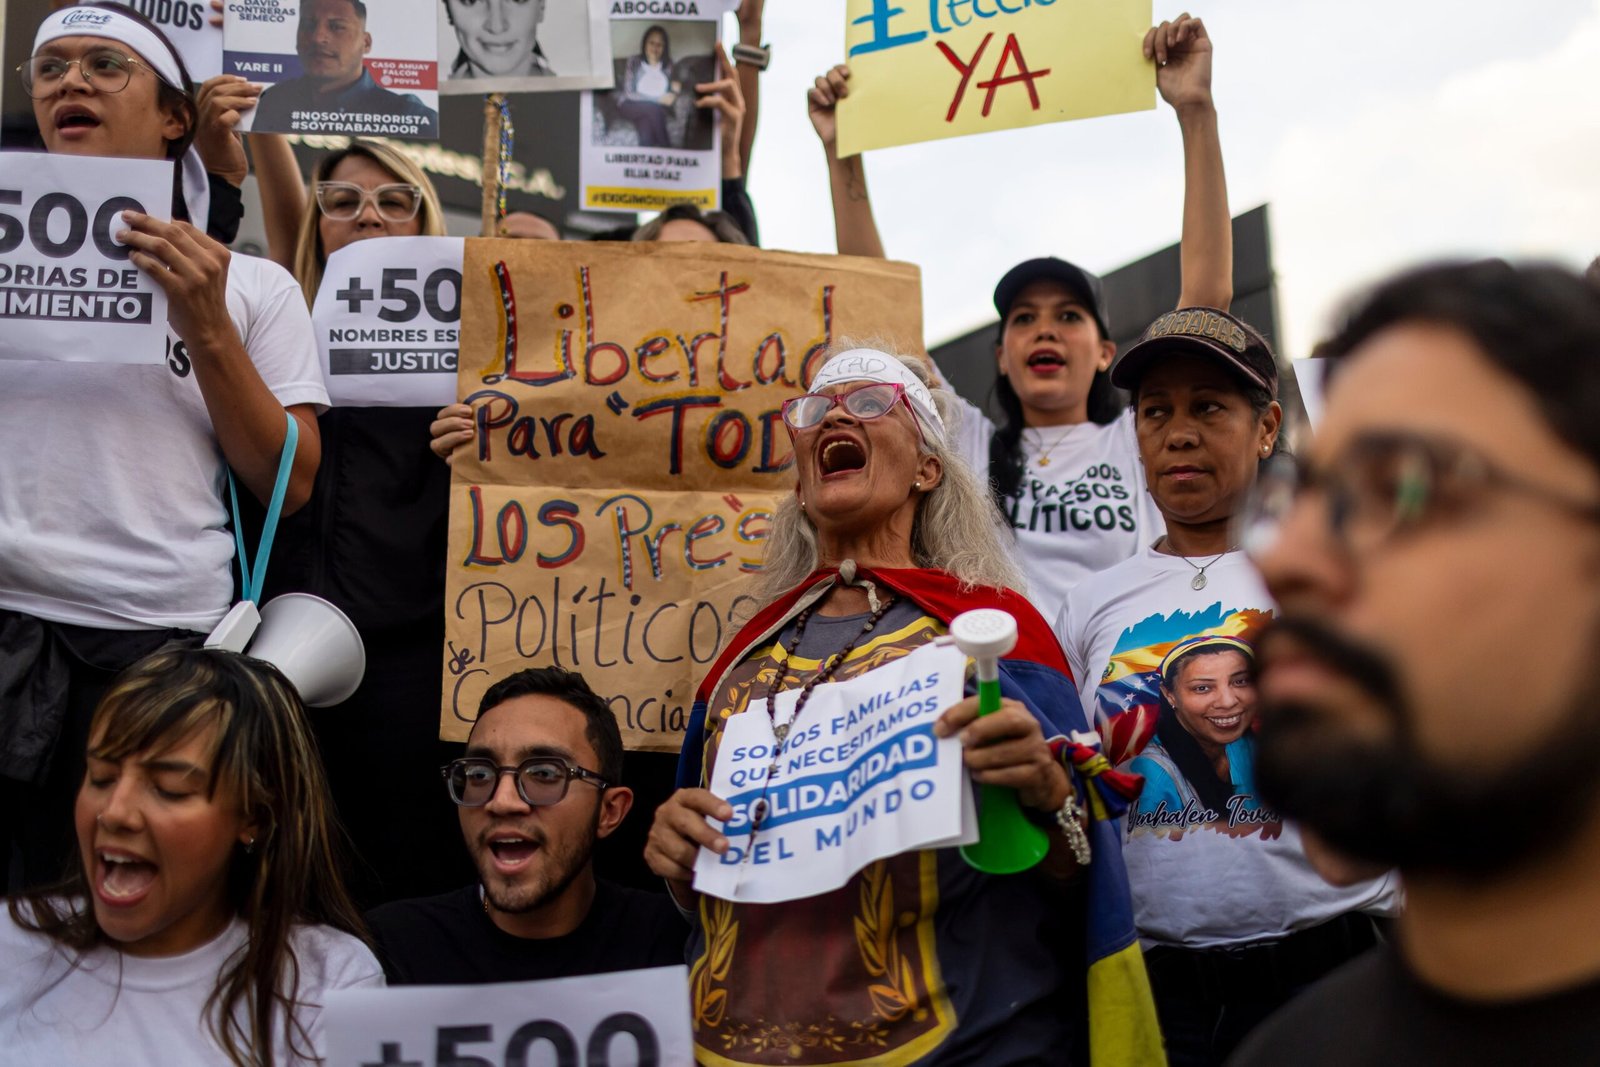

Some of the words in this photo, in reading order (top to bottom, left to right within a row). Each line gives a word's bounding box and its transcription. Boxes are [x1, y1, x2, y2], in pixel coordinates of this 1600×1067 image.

[229, 4, 296, 15] CONTRERAS
[611, 1, 699, 15] ABOGADA
[239, 13, 285, 23] SEMECO
[234, 61, 269, 72] YARE
[273, 63, 283, 73] II
[398, 63, 430, 71] AMUAY
[936, 32, 1051, 122] YA
[291, 111, 430, 125] #NOSOYTERRORISTA
[291, 120, 419, 134] #SOYTRABAJADOR
[605, 153, 664, 165] LIBERTAD
[667, 154, 699, 167] PARA
[97, 269, 139, 289] DE
[482, 260, 836, 391] Libertad
[329, 329, 428, 342] NOMBRES
[434, 330, 461, 342] ES
[463, 389, 607, 461] Para
[447, 640, 475, 675] de
[731, 724, 821, 762] SOMOS
[831, 672, 940, 735] FAMILIAS
[729, 766, 781, 788] QUE
[788, 696, 939, 774] NECESITAMOS
[727, 733, 935, 828] SOLIDARIDAD
[719, 837, 795, 866] DEL
[816, 779, 936, 851] MUNDO
